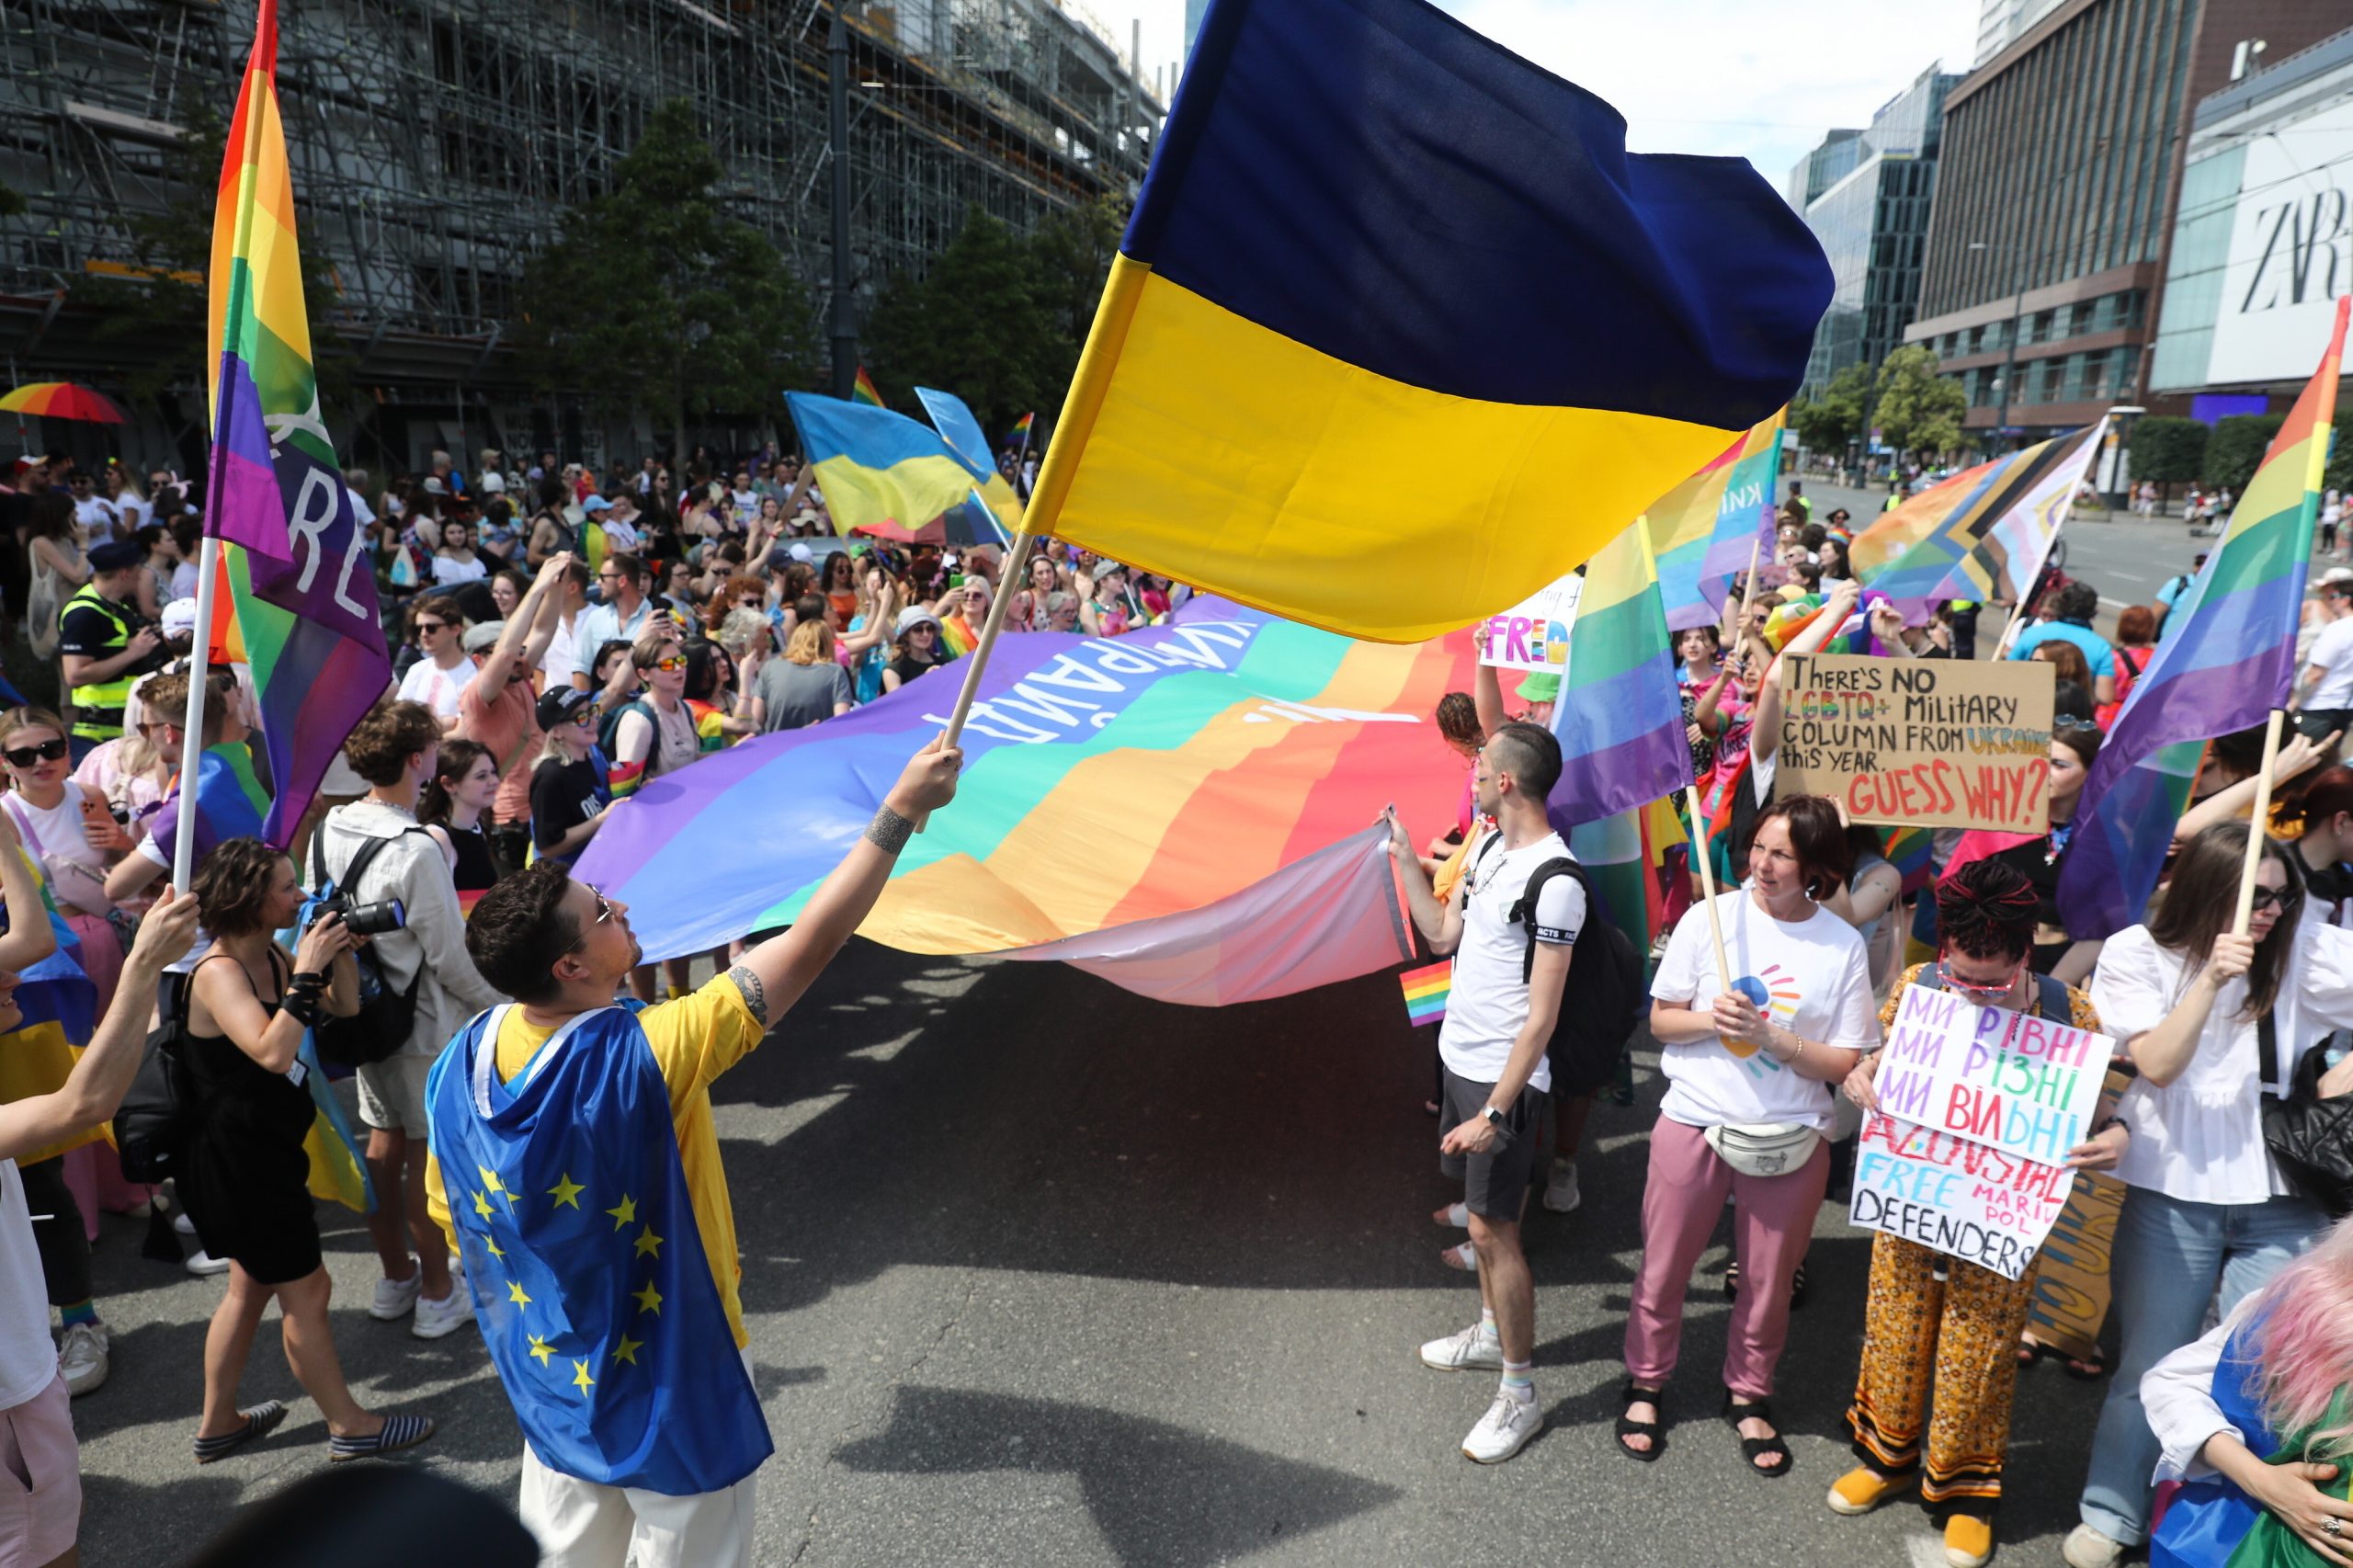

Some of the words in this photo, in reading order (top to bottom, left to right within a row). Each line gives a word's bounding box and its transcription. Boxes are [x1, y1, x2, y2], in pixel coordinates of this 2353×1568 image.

[2240, 187, 2353, 313] ZAR
[1892, 667, 1936, 694] NO
[1784, 688, 1892, 722] LGBTQ+
[1783, 721, 1897, 752] COLUMN
[1906, 725, 1963, 753] FROM
[1827, 750, 1886, 774] YEAR.
[1848, 758, 1956, 817] GUESS
[1956, 758, 2049, 825] WHY?
[1904, 987, 1958, 1030] МИ
[1891, 1026, 1946, 1069] МИ
[1877, 1065, 1933, 1118] МИ
[1859, 1152, 1964, 1209] FREE
[1985, 1205, 2032, 1235] POL
